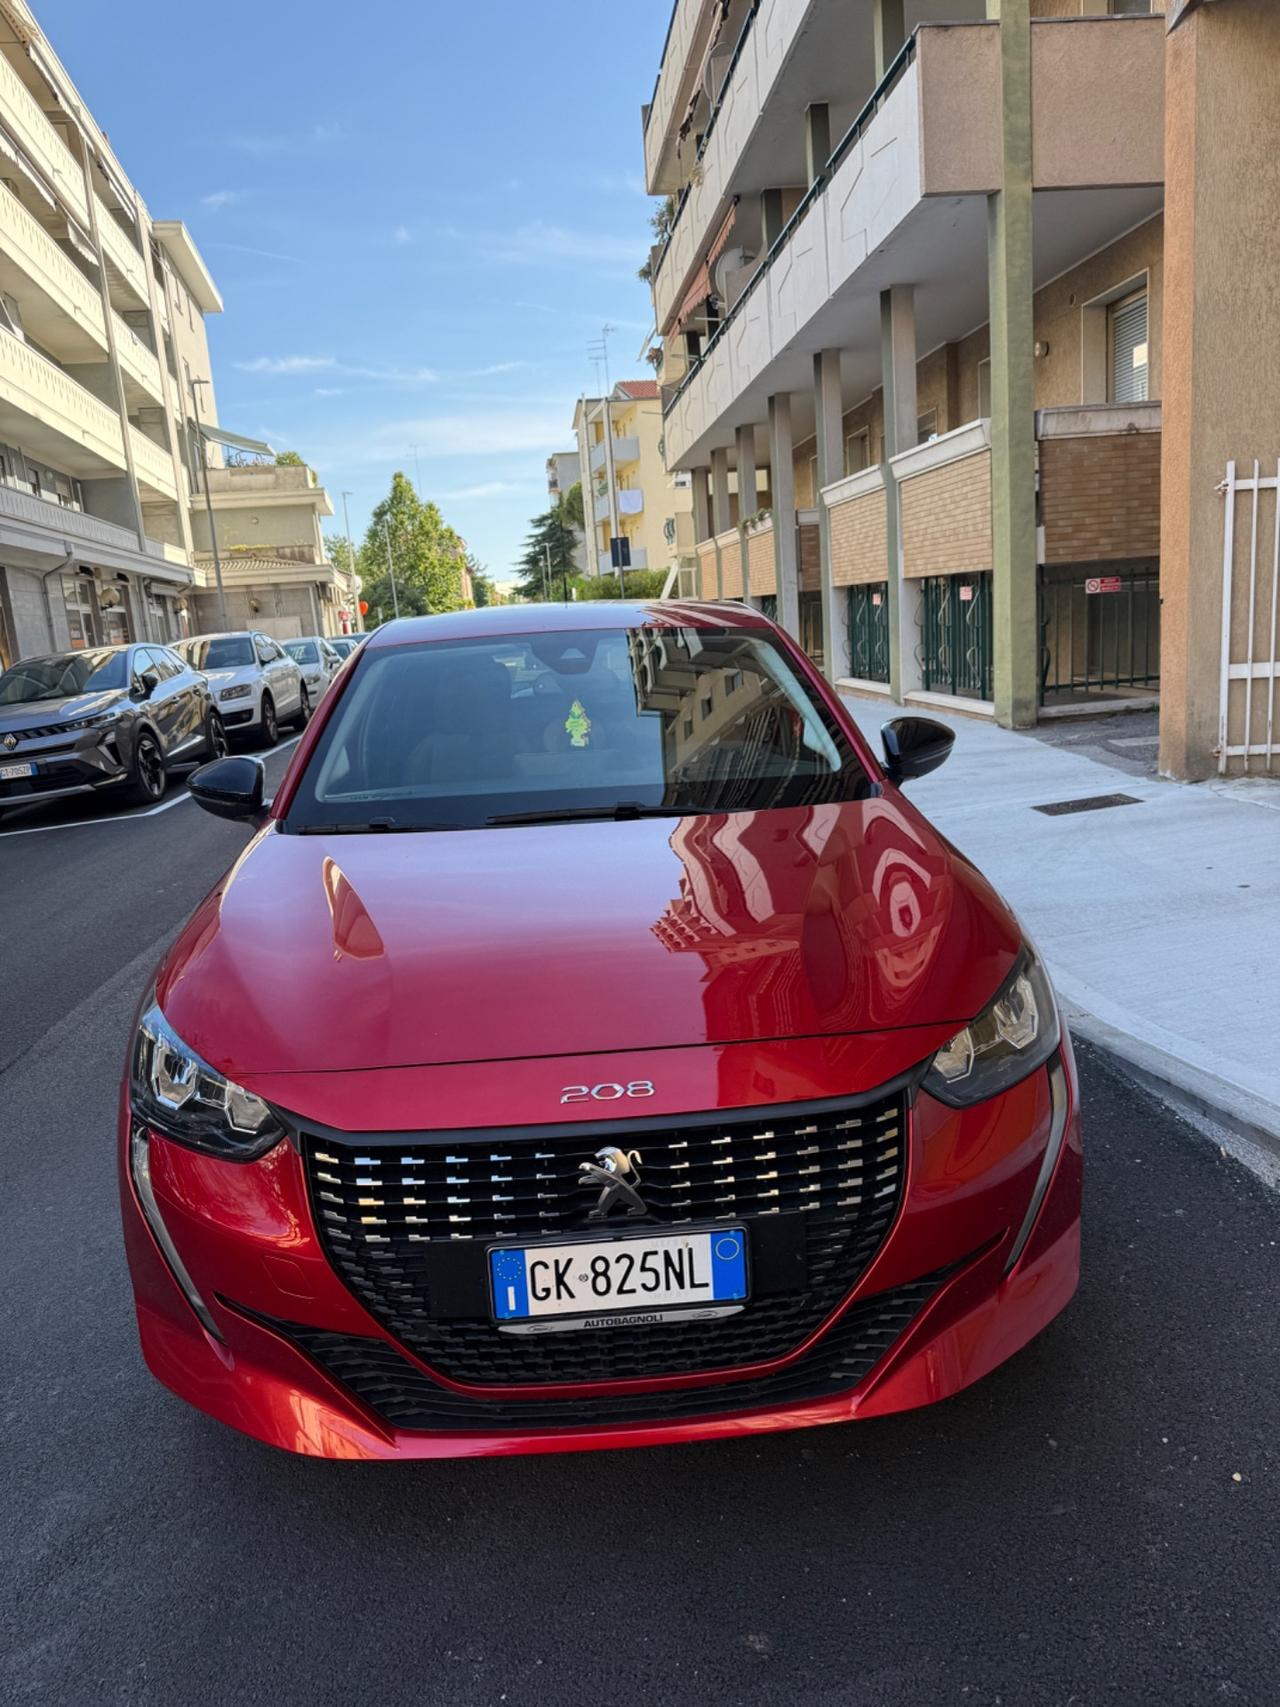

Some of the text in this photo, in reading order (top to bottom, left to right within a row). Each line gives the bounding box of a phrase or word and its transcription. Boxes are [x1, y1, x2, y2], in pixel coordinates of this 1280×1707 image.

[560, 1080, 655, 1104] 208
[530, 1257, 576, 1301] GK
[590, 1247, 709, 1297] 825NL
[583, 1314, 663, 1329] AUTOBAGNOLI
